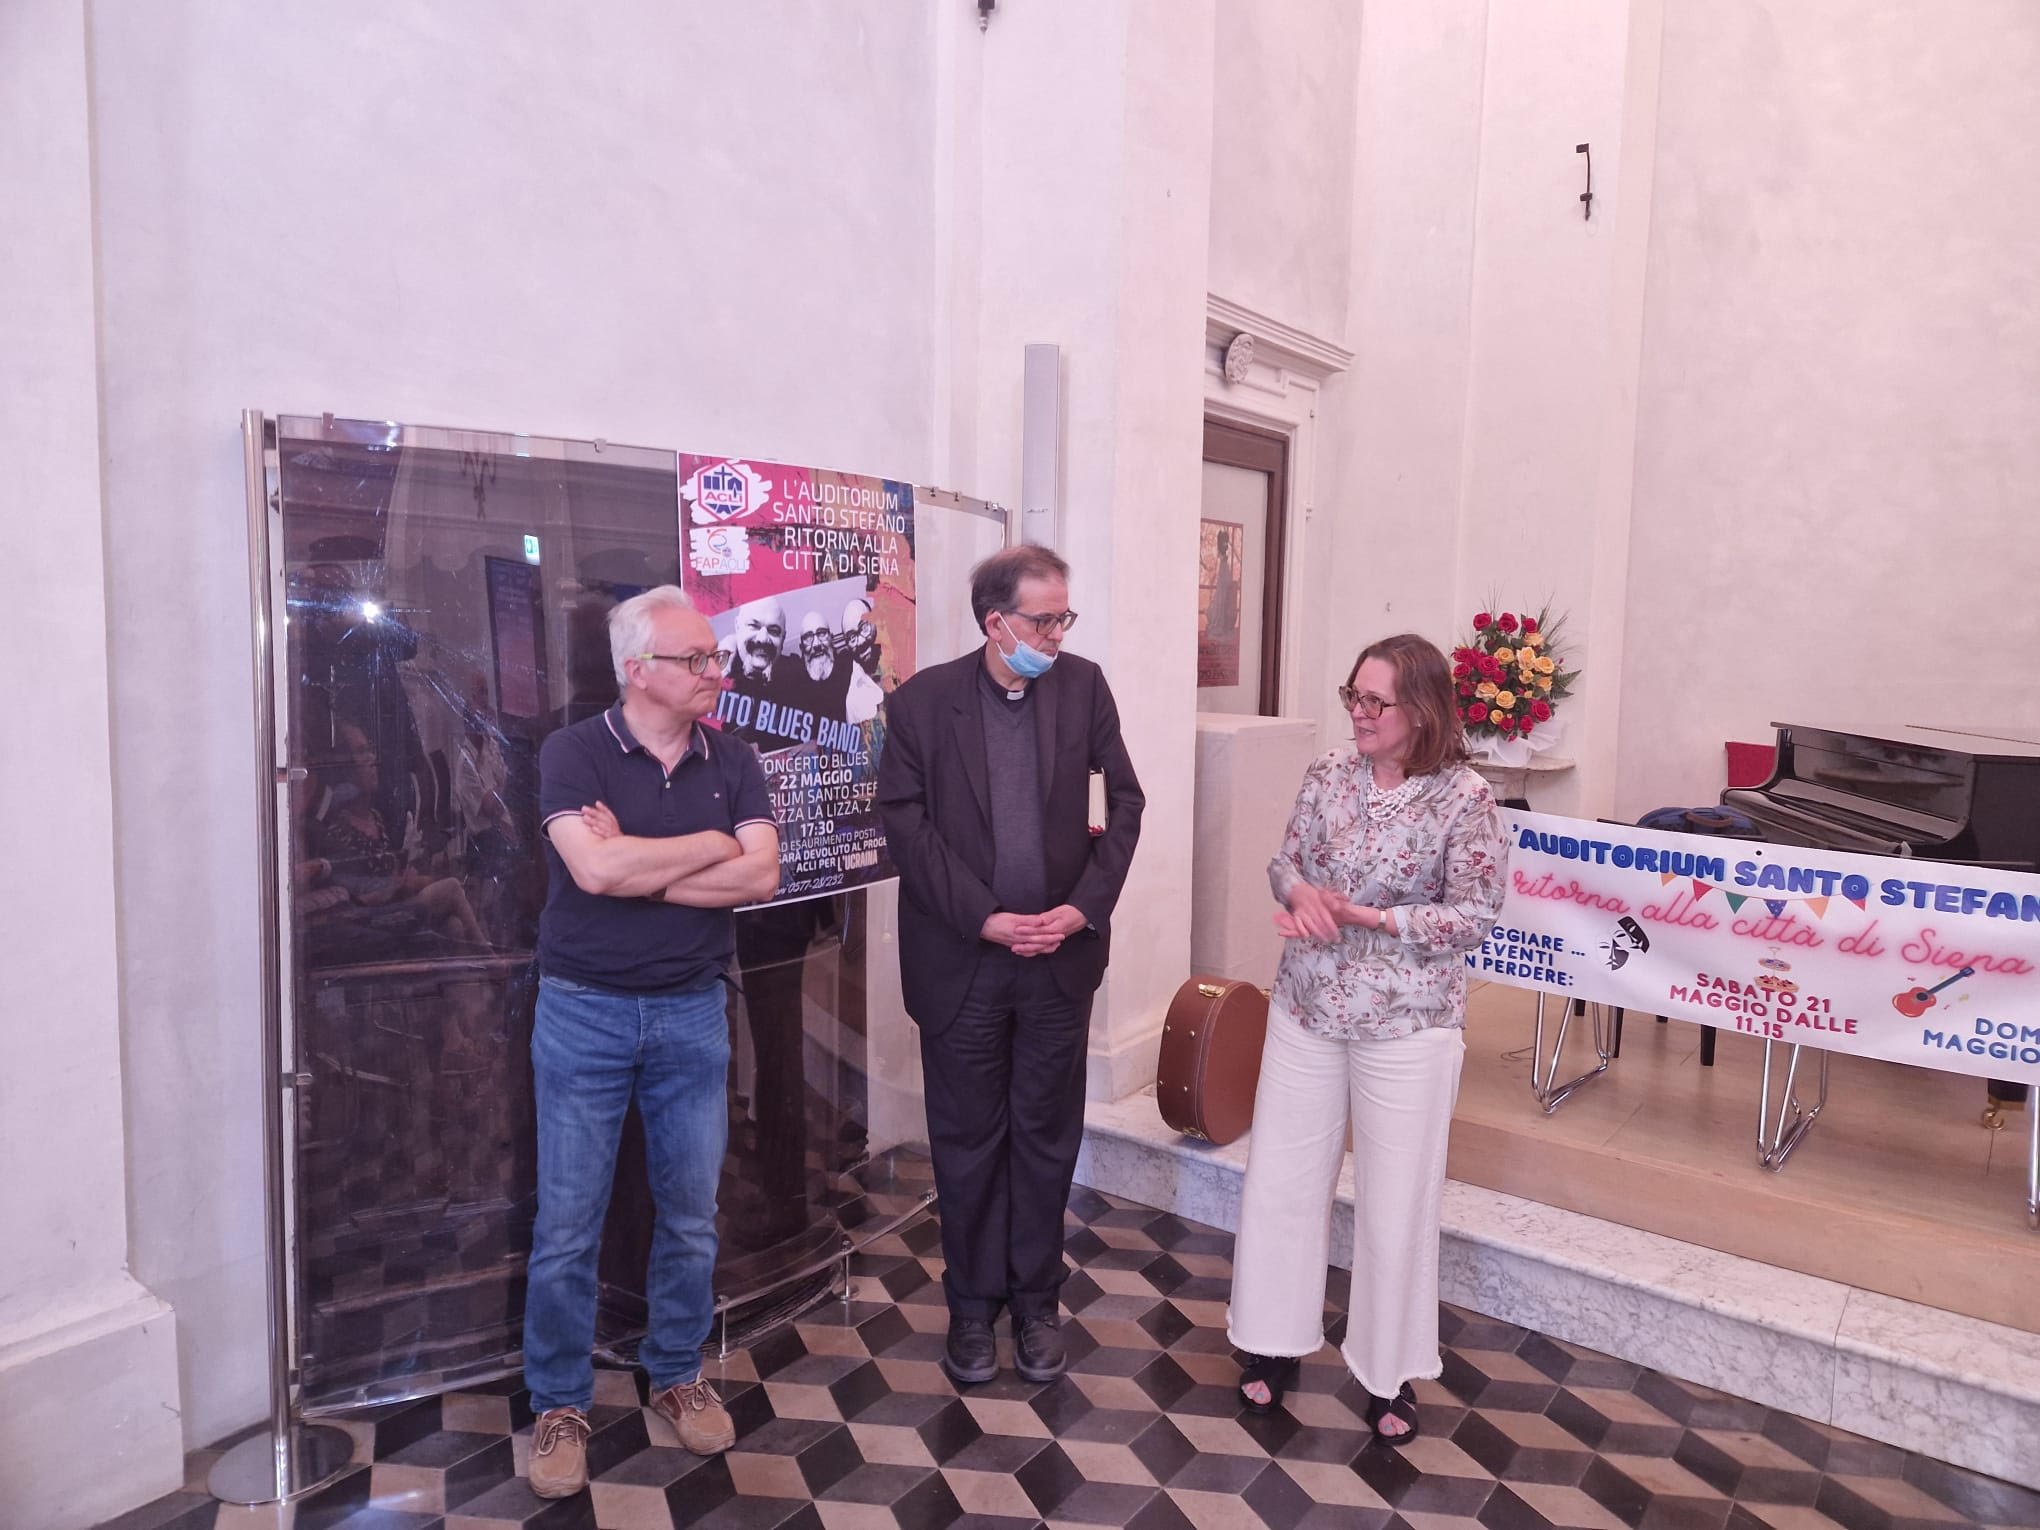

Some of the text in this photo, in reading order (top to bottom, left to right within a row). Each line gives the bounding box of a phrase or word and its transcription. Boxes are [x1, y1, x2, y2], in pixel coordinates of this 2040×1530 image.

[704, 491, 743, 503] ACLI
[783, 479, 899, 511] L'AUDITORIUM
[772, 502, 905, 534] SANTO STEFANO
[784, 526, 898, 555] RITORNA ALLA
[782, 547, 899, 576] CITTÀ DI SIENA
[706, 690, 861, 753] ITO BLUES BAND
[760, 751, 869, 775] ONCERTO BLUES
[780, 769, 853, 790] 22 MAGGIO
[807, 785, 849, 804] SANTO
[808, 805, 823, 820] LA
[826, 801, 862, 818] LIZZA,
[864, 799, 872, 812] 2
[790, 832, 852, 851] ESAURIMENTO
[854, 828, 876, 840] POSTI
[800, 820, 834, 838] 17:30
[803, 843, 851, 860] DEVOLUTO
[852, 840, 862, 852] AL
[796, 861, 816, 873] ACLI
[818, 857, 836, 869] PER
[1512, 823, 2040, 923] 'AUDITORIUM SANTO STEFAN
[1513, 869, 2035, 975] ritorna alla città di Siena
[1490, 926, 1565, 953] GGIARE
[1481, 941, 1554, 967] EVENTI
[1483, 957, 1574, 986] PERDERE:
[1696, 973, 1831, 1014] SABATO 21
[1669, 985, 1859, 1035] MAGGIO DALLE
[1735, 1015, 1785, 1039] 11.15
[1974, 1017, 2040, 1045] DOM
[1922, 1029, 2040, 1064] MAGGIO
